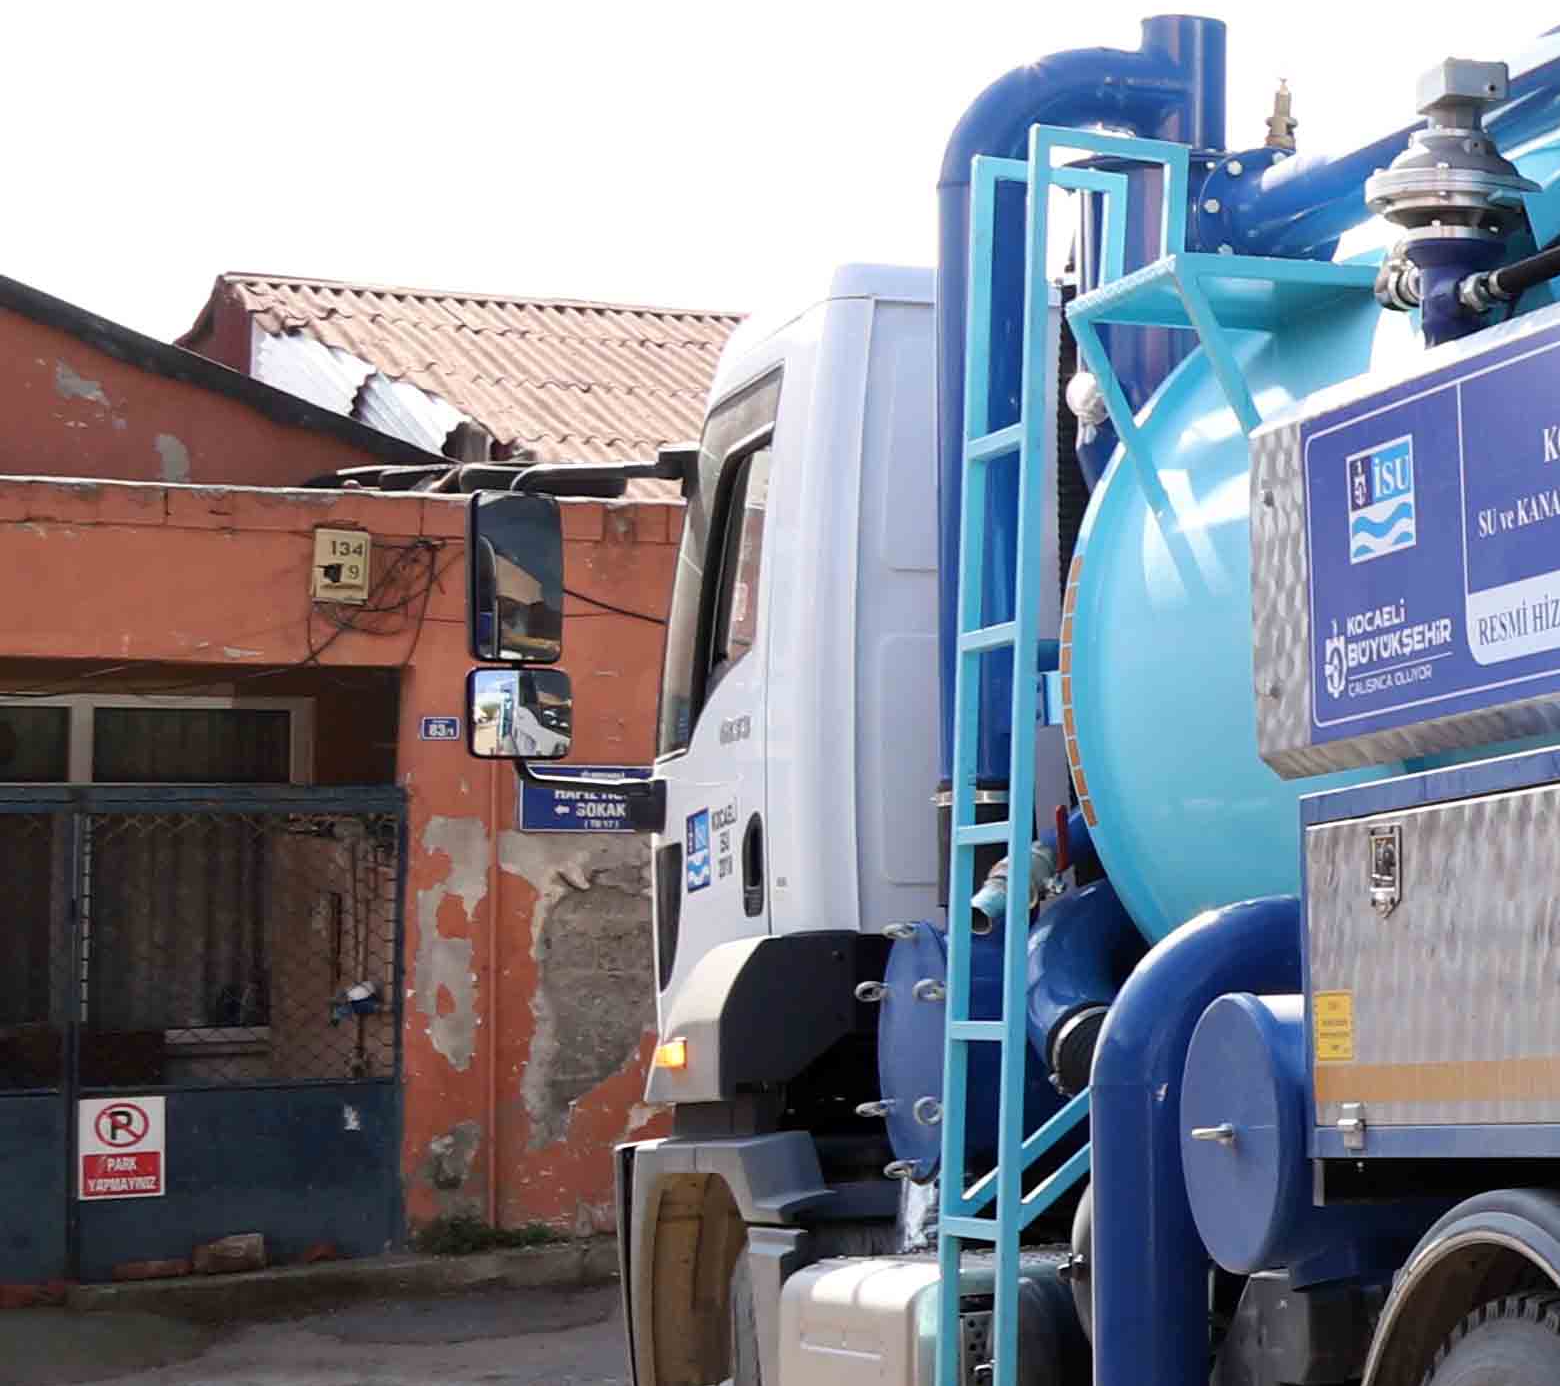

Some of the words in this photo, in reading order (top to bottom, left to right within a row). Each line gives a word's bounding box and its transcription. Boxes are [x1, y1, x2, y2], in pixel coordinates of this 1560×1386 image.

[1477, 508, 1497, 539] SU
[1499, 512, 1514, 532] ve
[331, 539, 364, 557] 134
[1478, 599, 1529, 646] RESMİ
